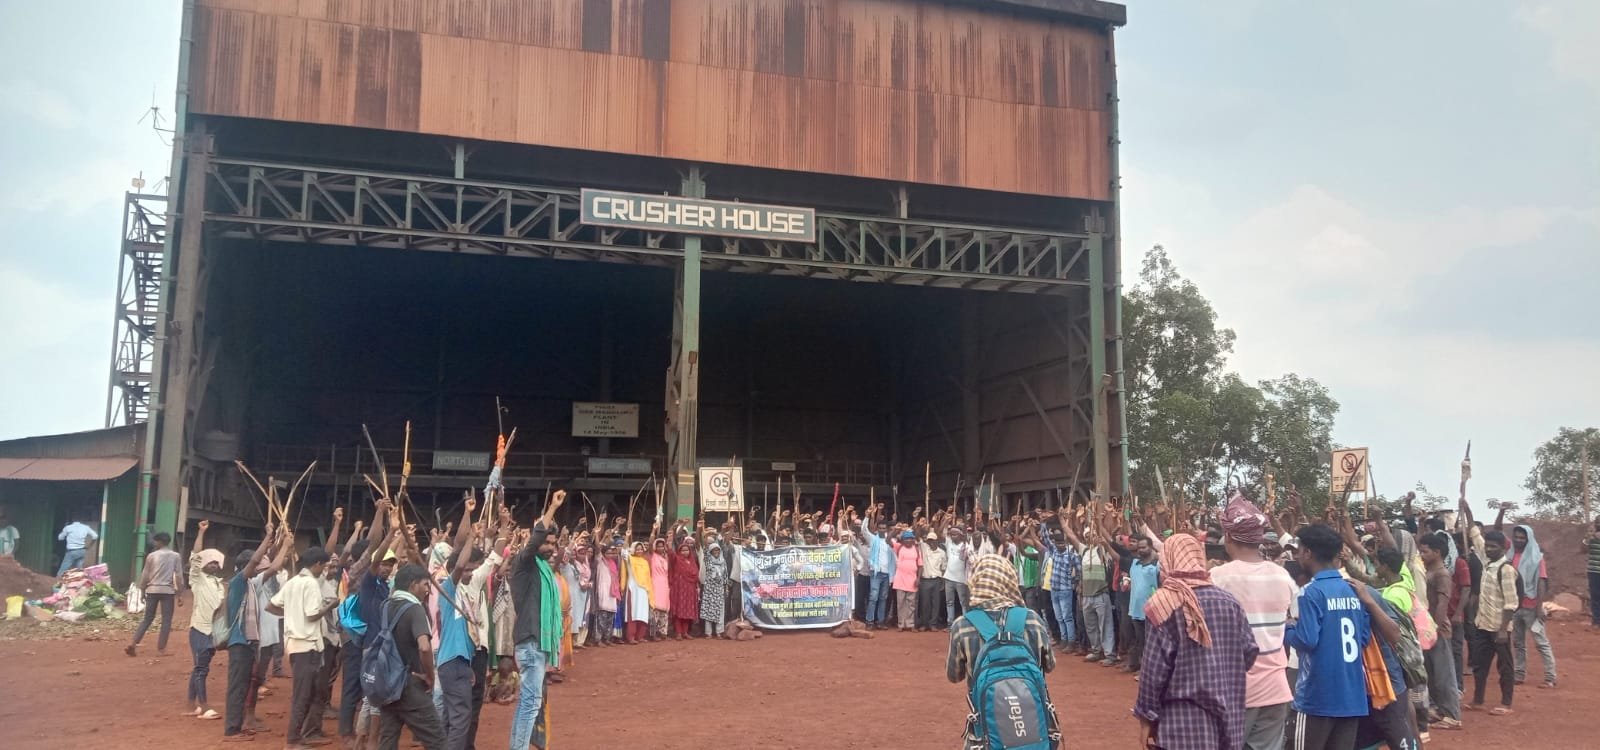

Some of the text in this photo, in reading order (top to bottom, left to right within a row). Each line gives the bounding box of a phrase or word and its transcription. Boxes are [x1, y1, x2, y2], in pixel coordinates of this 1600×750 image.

[592, 196, 805, 234] CRUSHER HOUSE
[437, 455, 486, 467] NORTH LINE
[713, 477, 729, 488] 05
[1327, 597, 1361, 611] MANISH
[1004, 695, 1027, 738] safari
